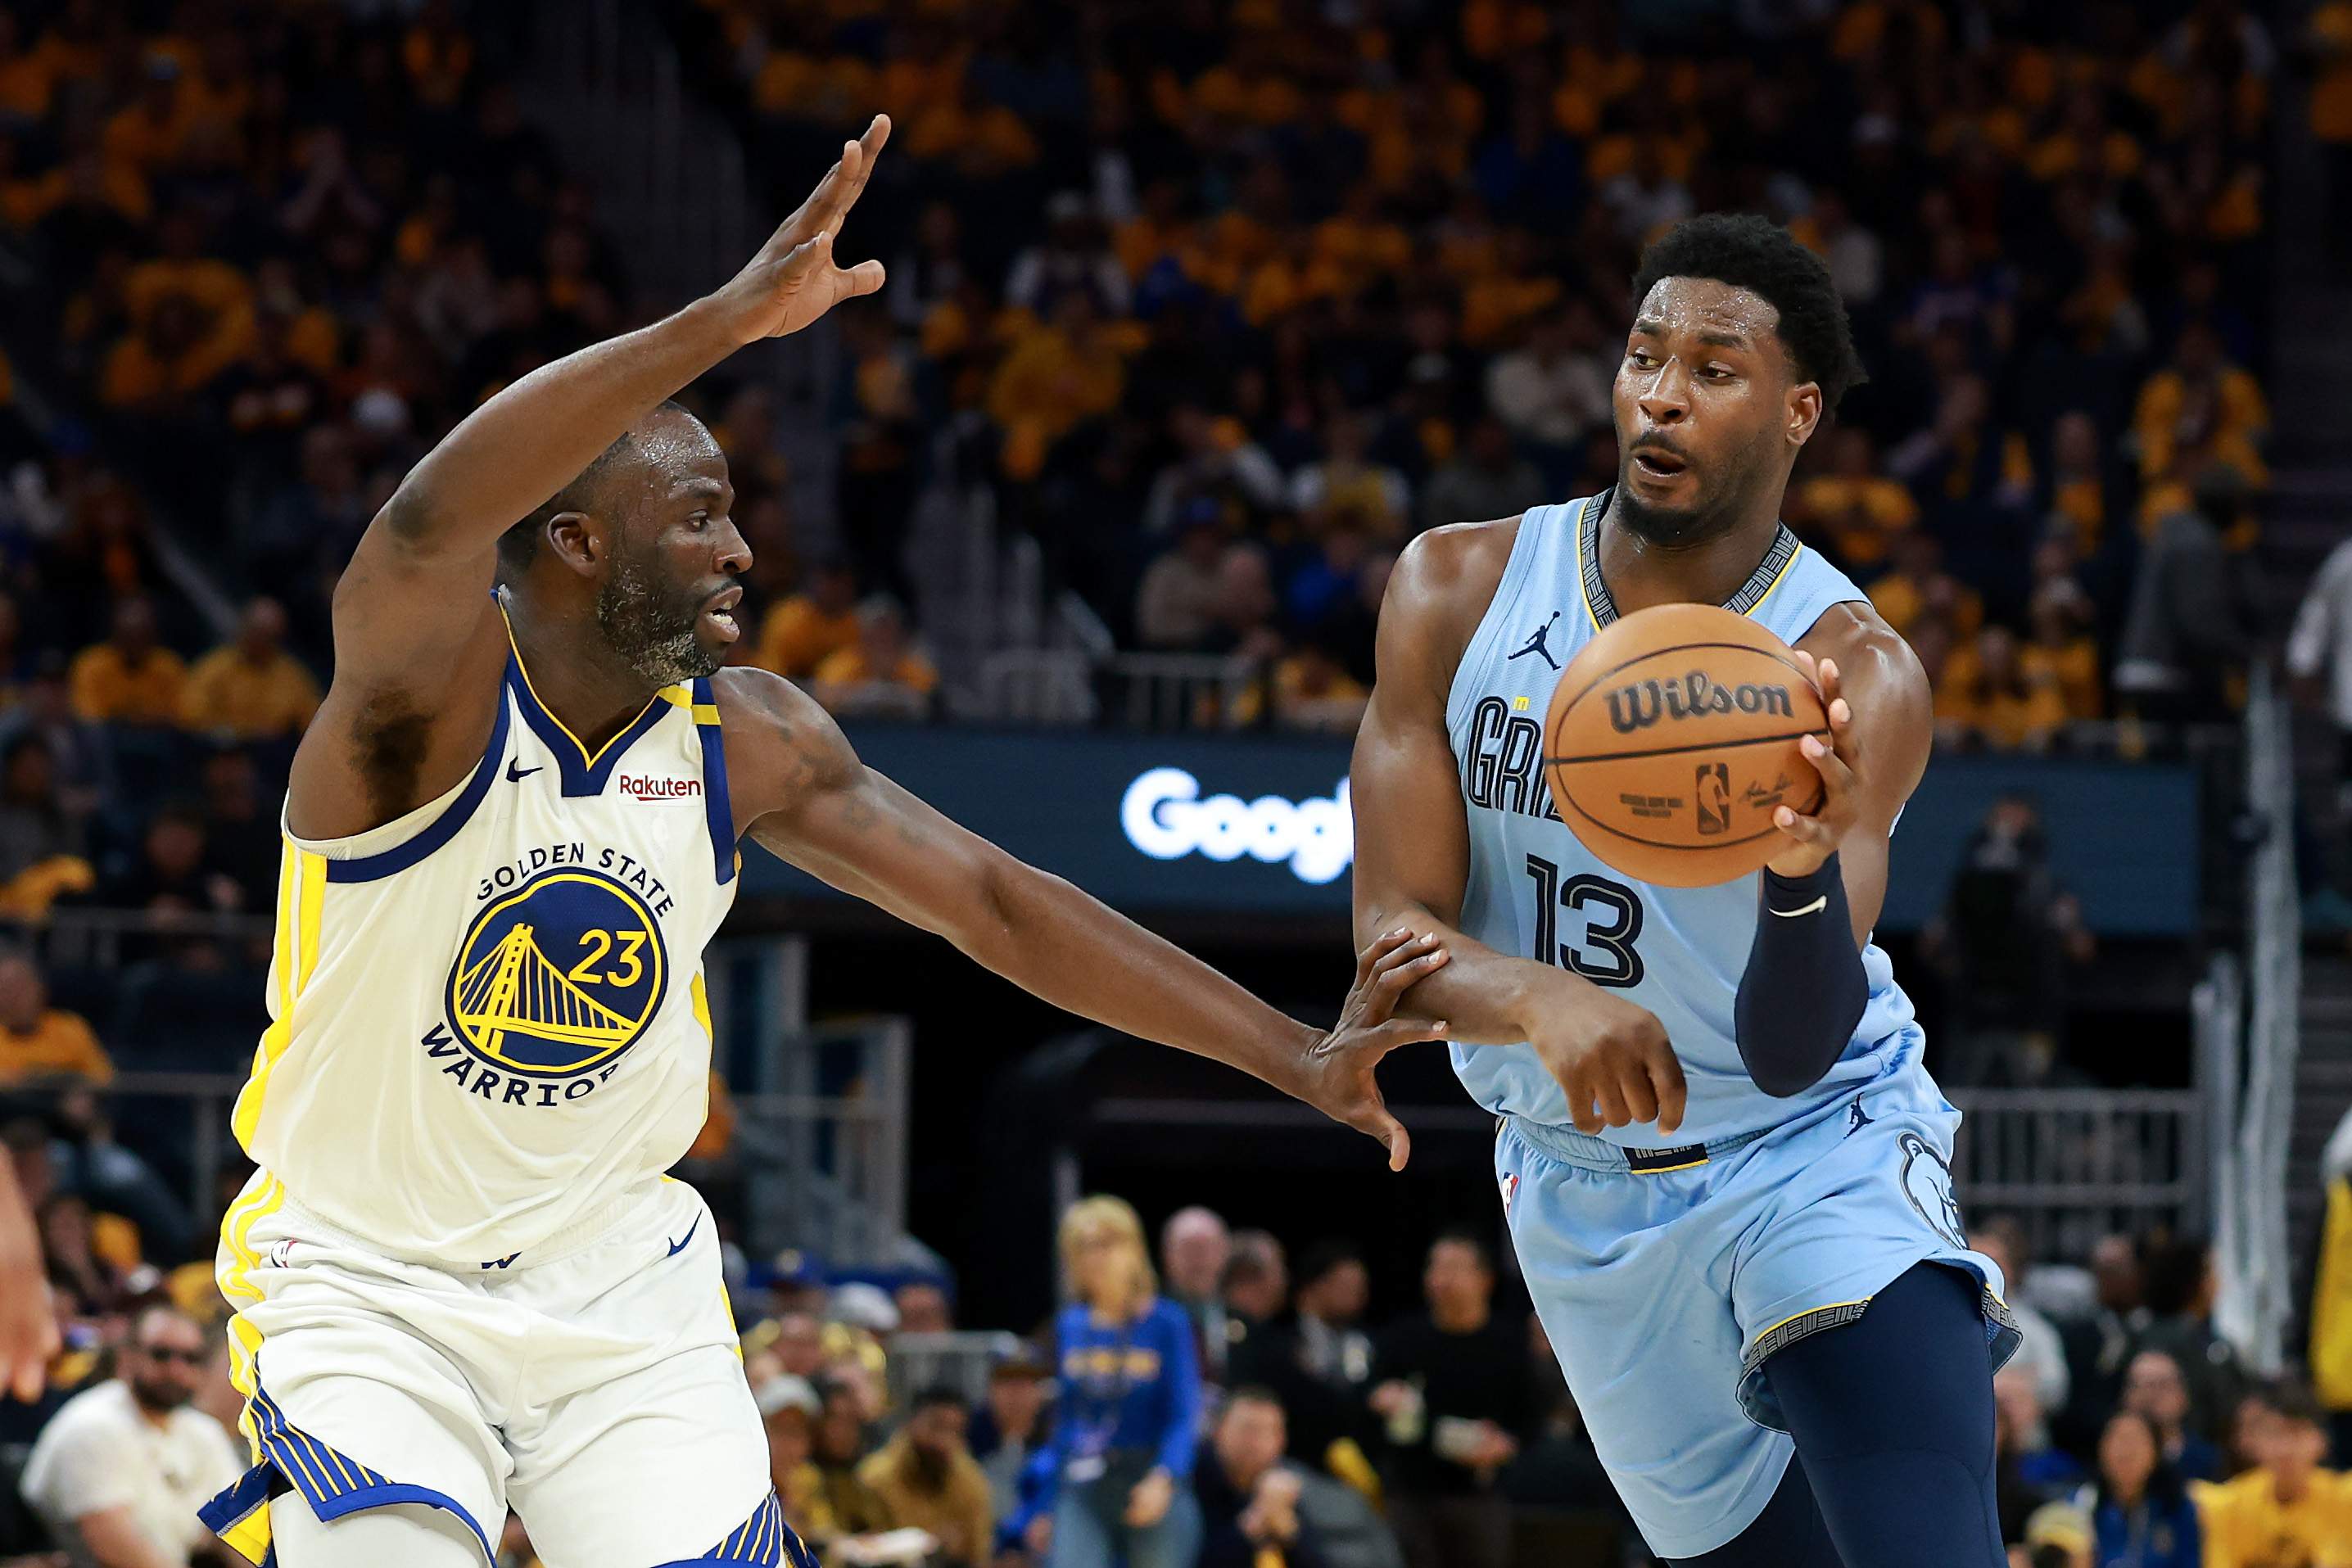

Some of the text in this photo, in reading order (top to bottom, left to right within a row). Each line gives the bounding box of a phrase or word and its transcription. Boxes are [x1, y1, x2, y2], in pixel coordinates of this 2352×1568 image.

[1603, 670, 1794, 734] Wilson
[619, 775, 701, 796] Rakuten
[1468, 696, 1565, 824] GRI
[477, 843, 674, 918] GOLDEN STATE
[1527, 853, 1644, 988] 13
[568, 929, 647, 987] 23
